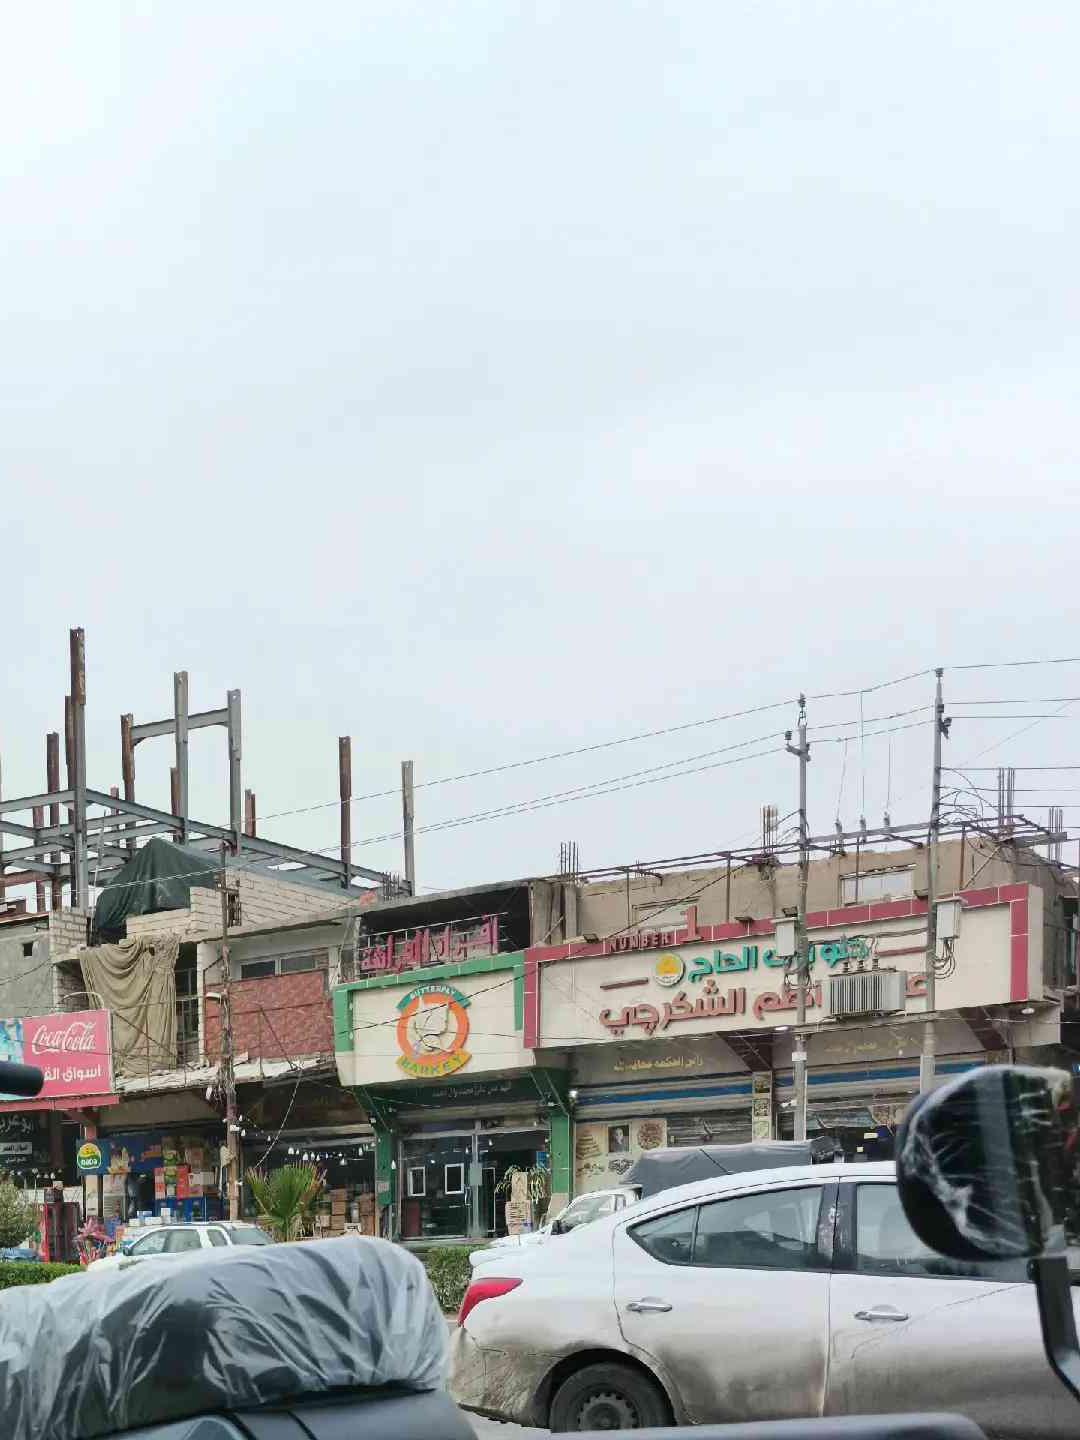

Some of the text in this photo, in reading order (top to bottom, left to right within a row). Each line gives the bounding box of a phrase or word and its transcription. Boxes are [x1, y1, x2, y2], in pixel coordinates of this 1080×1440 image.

[609, 905, 703, 952] NUMBER 1
[687, 944, 758, 984] الحاج
